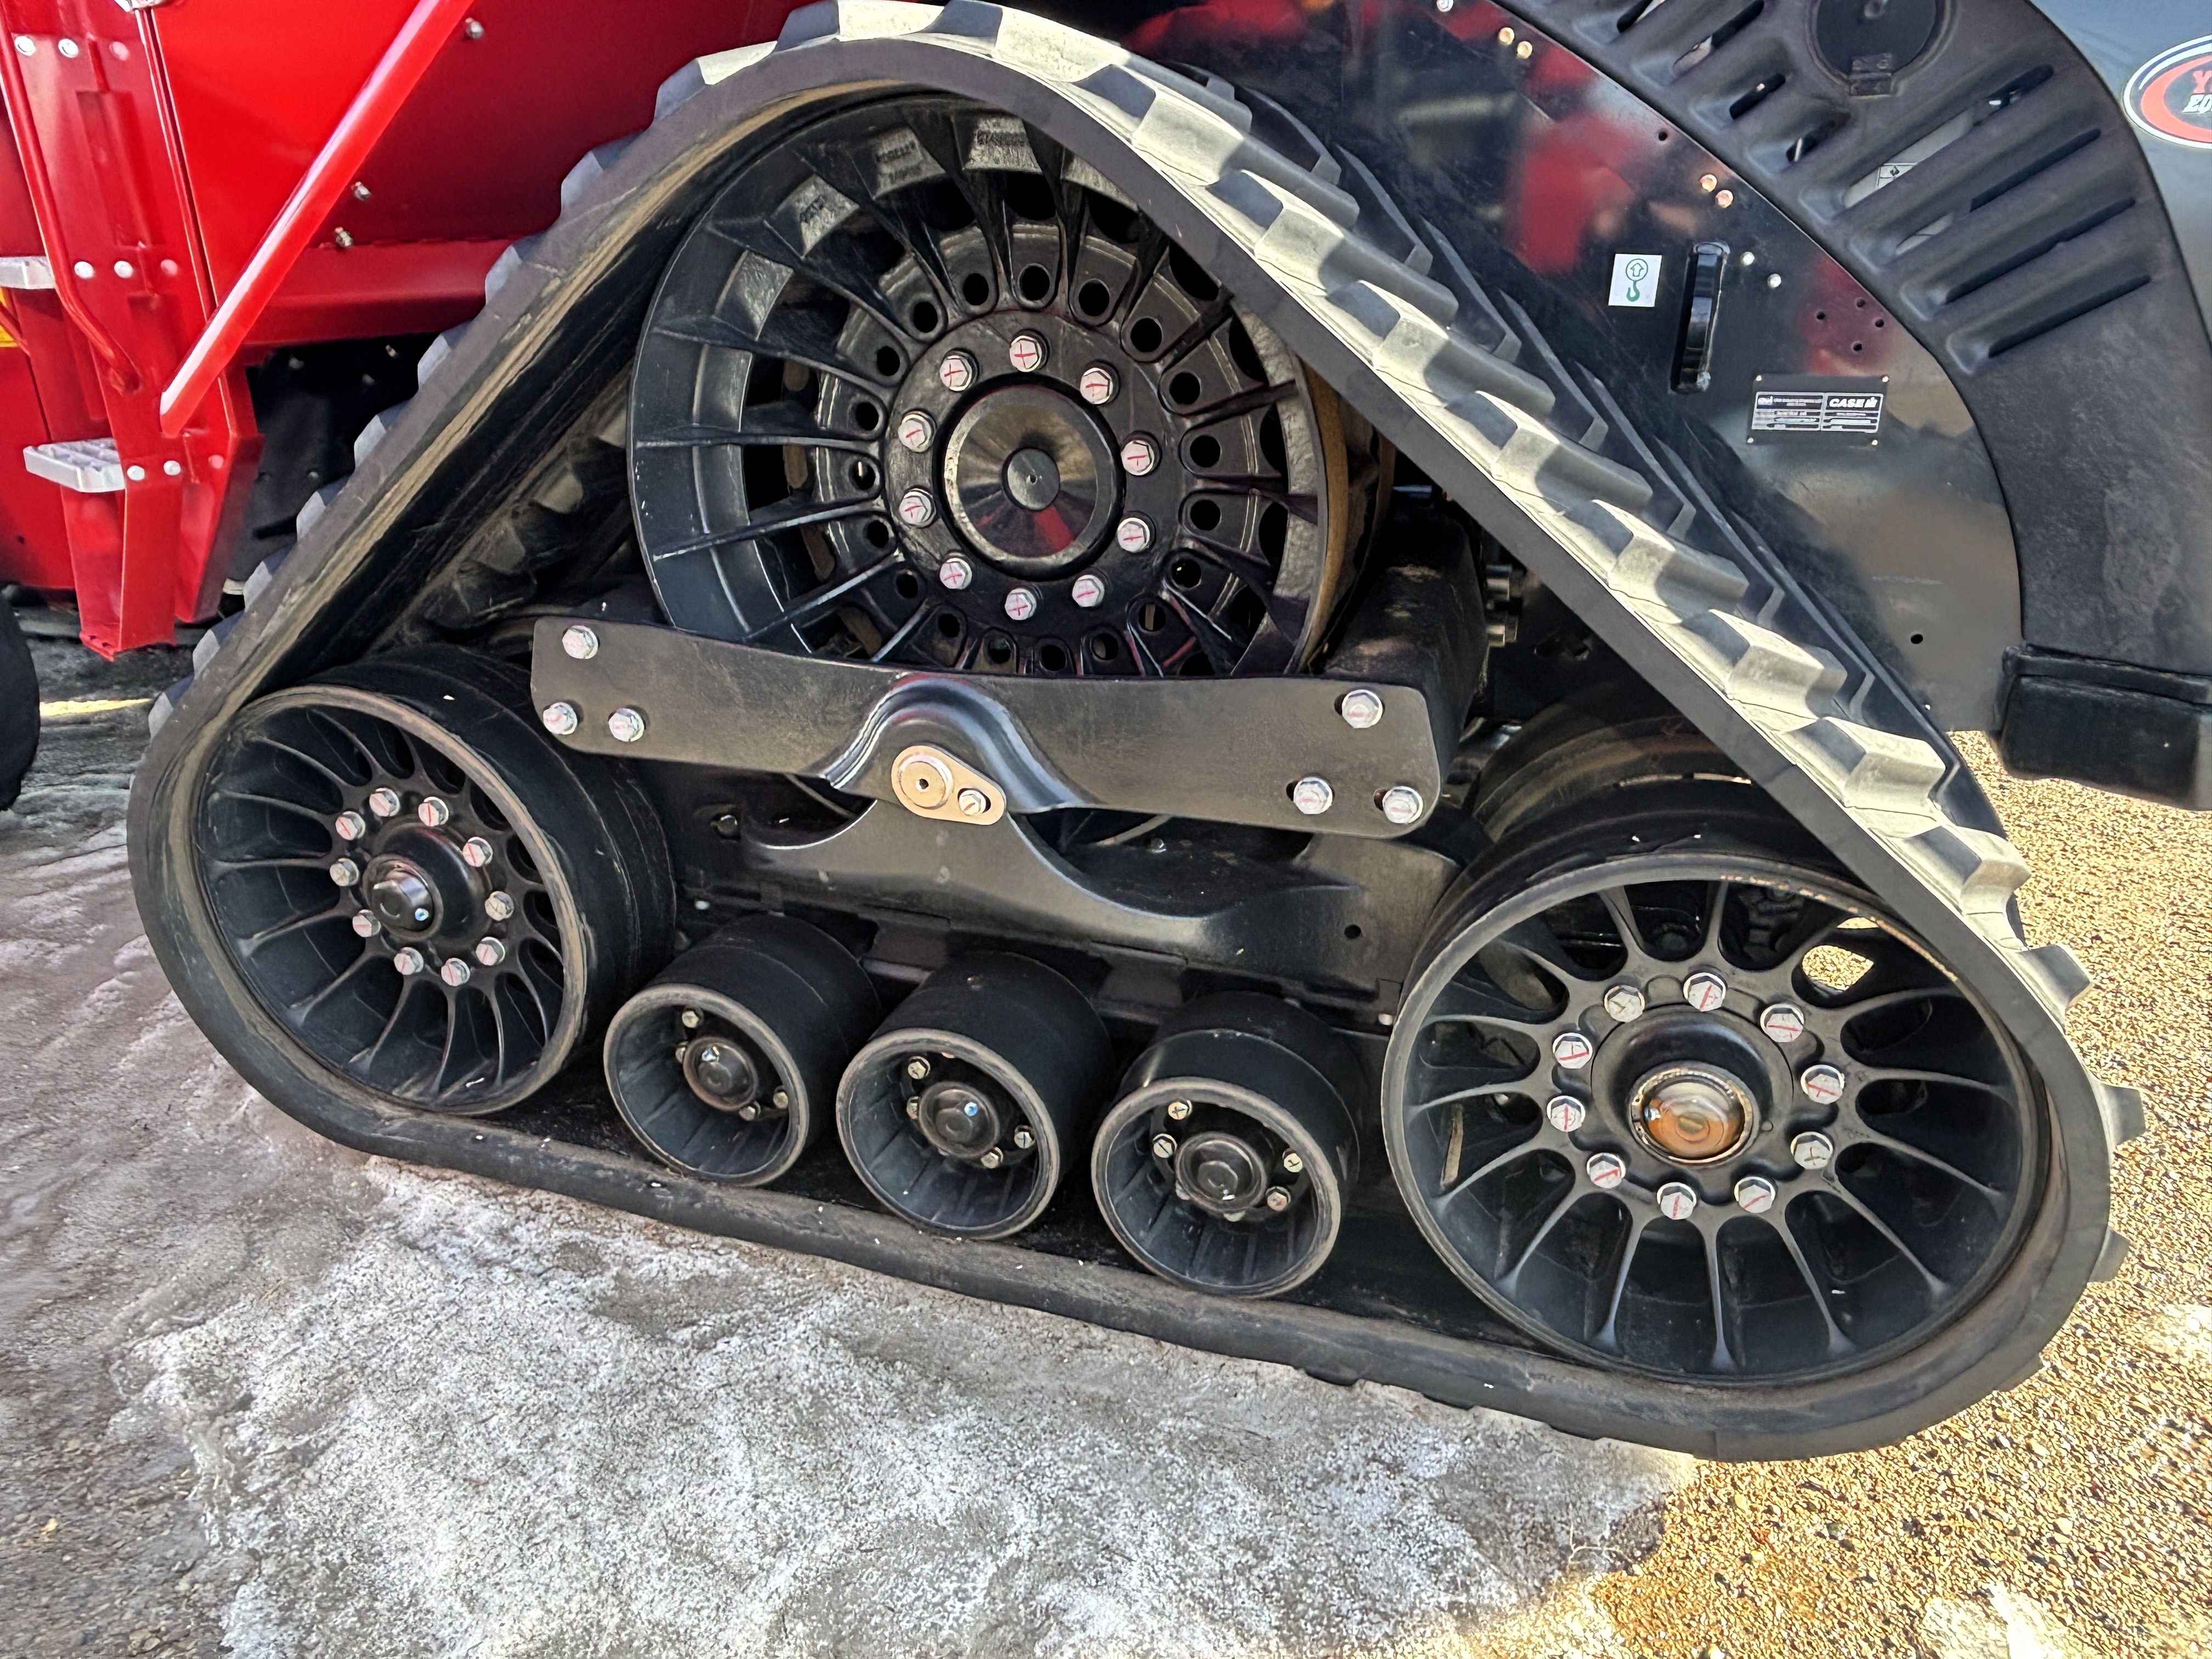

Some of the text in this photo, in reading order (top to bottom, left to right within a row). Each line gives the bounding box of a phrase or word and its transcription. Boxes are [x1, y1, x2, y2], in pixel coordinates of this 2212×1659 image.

[2193, 71, 2212, 93] Y
[2182, 94, 2212, 115] EQ
[1829, 398, 1865, 408] CASE
